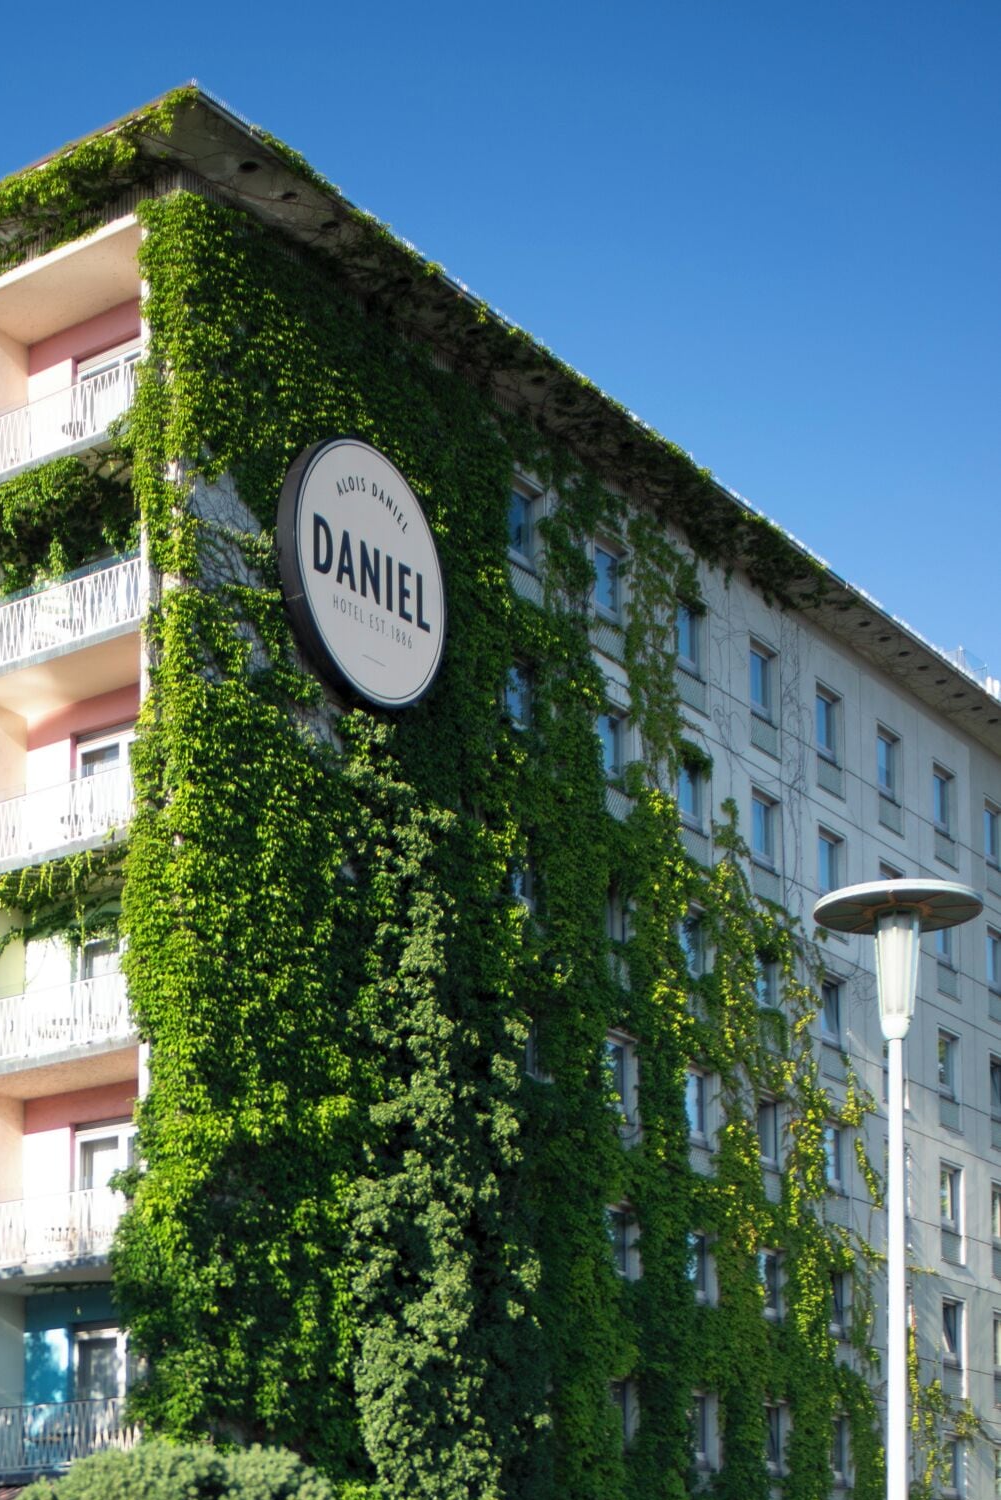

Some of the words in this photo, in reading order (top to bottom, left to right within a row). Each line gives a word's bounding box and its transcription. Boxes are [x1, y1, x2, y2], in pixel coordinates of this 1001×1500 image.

[336, 476, 366, 497] ALOIS
[372, 482, 408, 535] DANIEL
[313, 512, 431, 634] DANIEL
[333, 594, 364, 624] HOTEL
